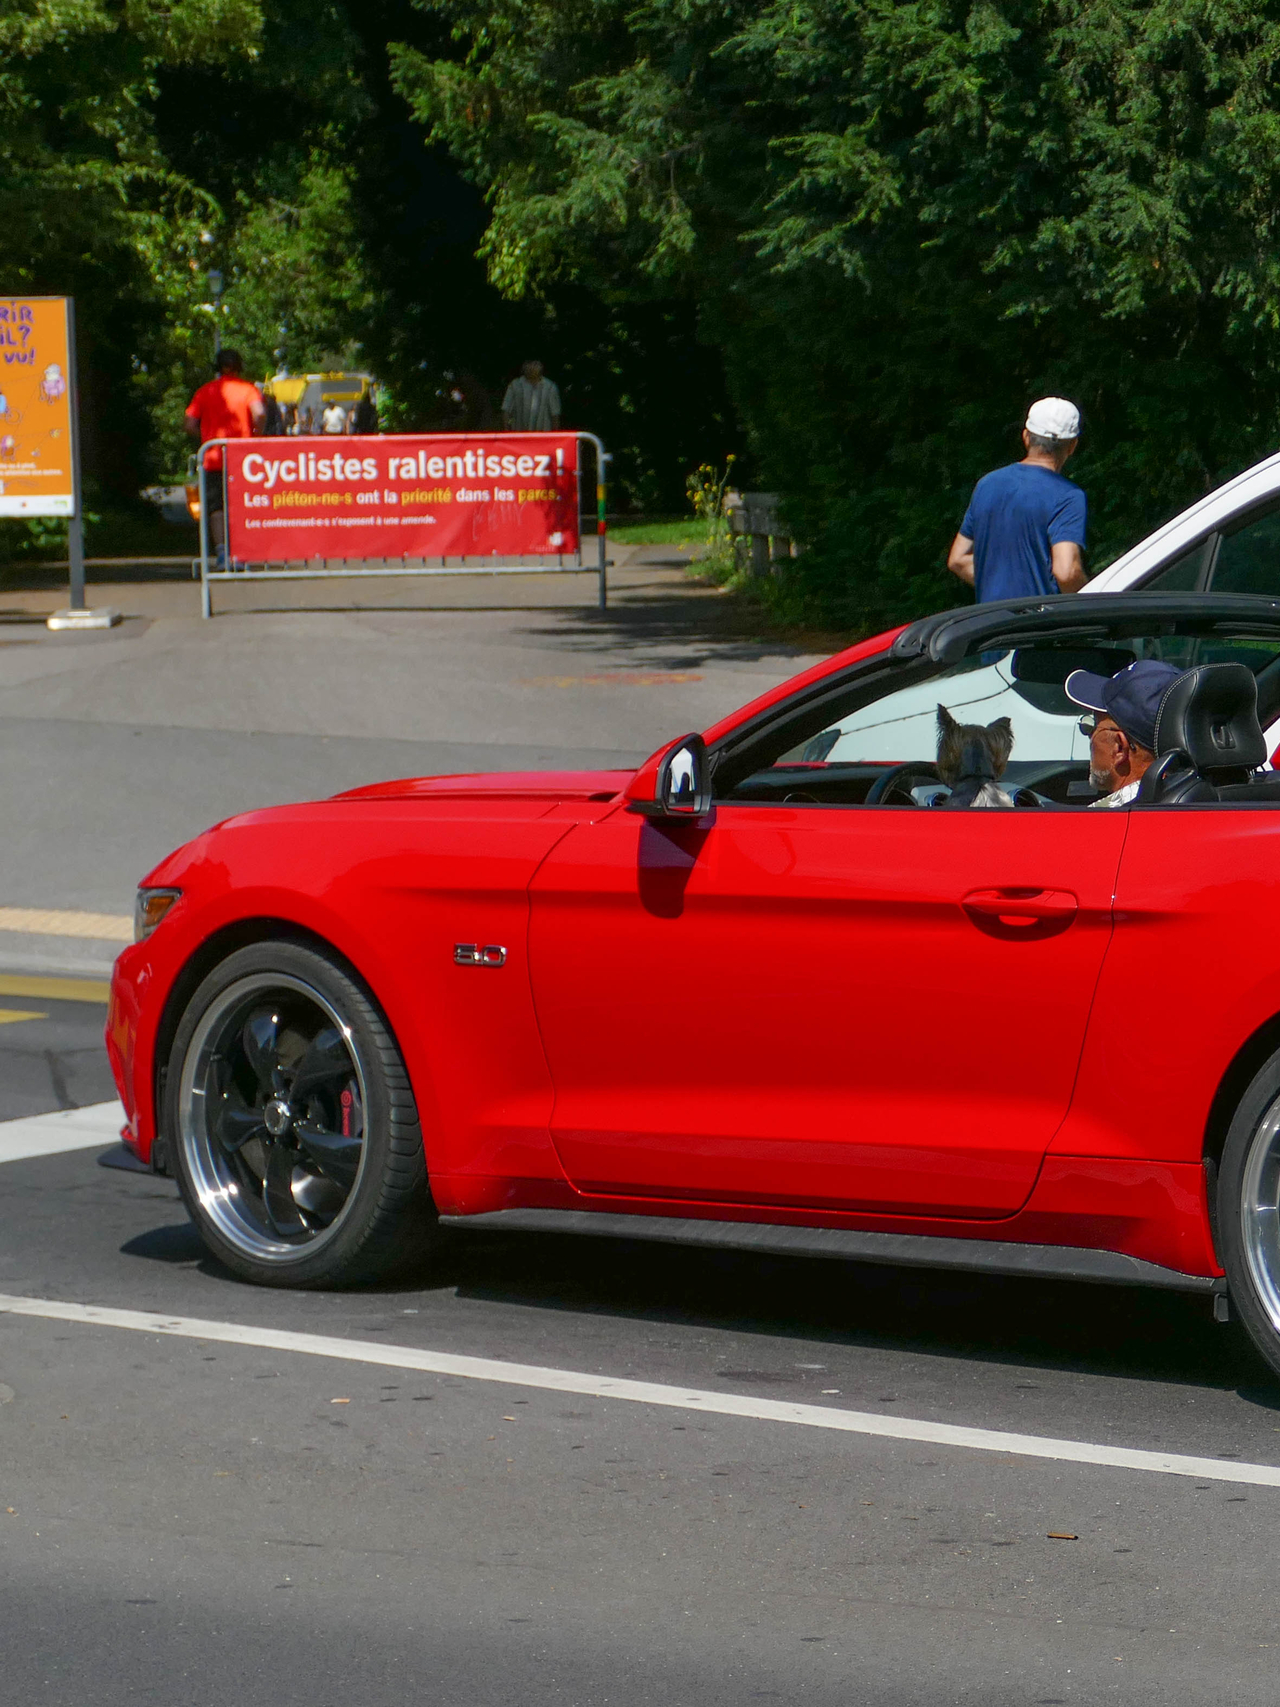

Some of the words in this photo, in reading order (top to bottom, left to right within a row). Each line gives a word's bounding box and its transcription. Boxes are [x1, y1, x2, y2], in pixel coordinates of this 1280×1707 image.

[242, 452, 378, 489] Cyclistes
[243, 491, 269, 507] Les
[356, 489, 380, 504] ont
[384, 488, 398, 504] la
[401, 486, 452, 507] priorité
[456, 487, 490, 502] dans
[494, 486, 515, 501] les
[245, 518, 261, 529] Les
[383, 516, 399, 525] une
[454, 943, 507, 966] 5.0
